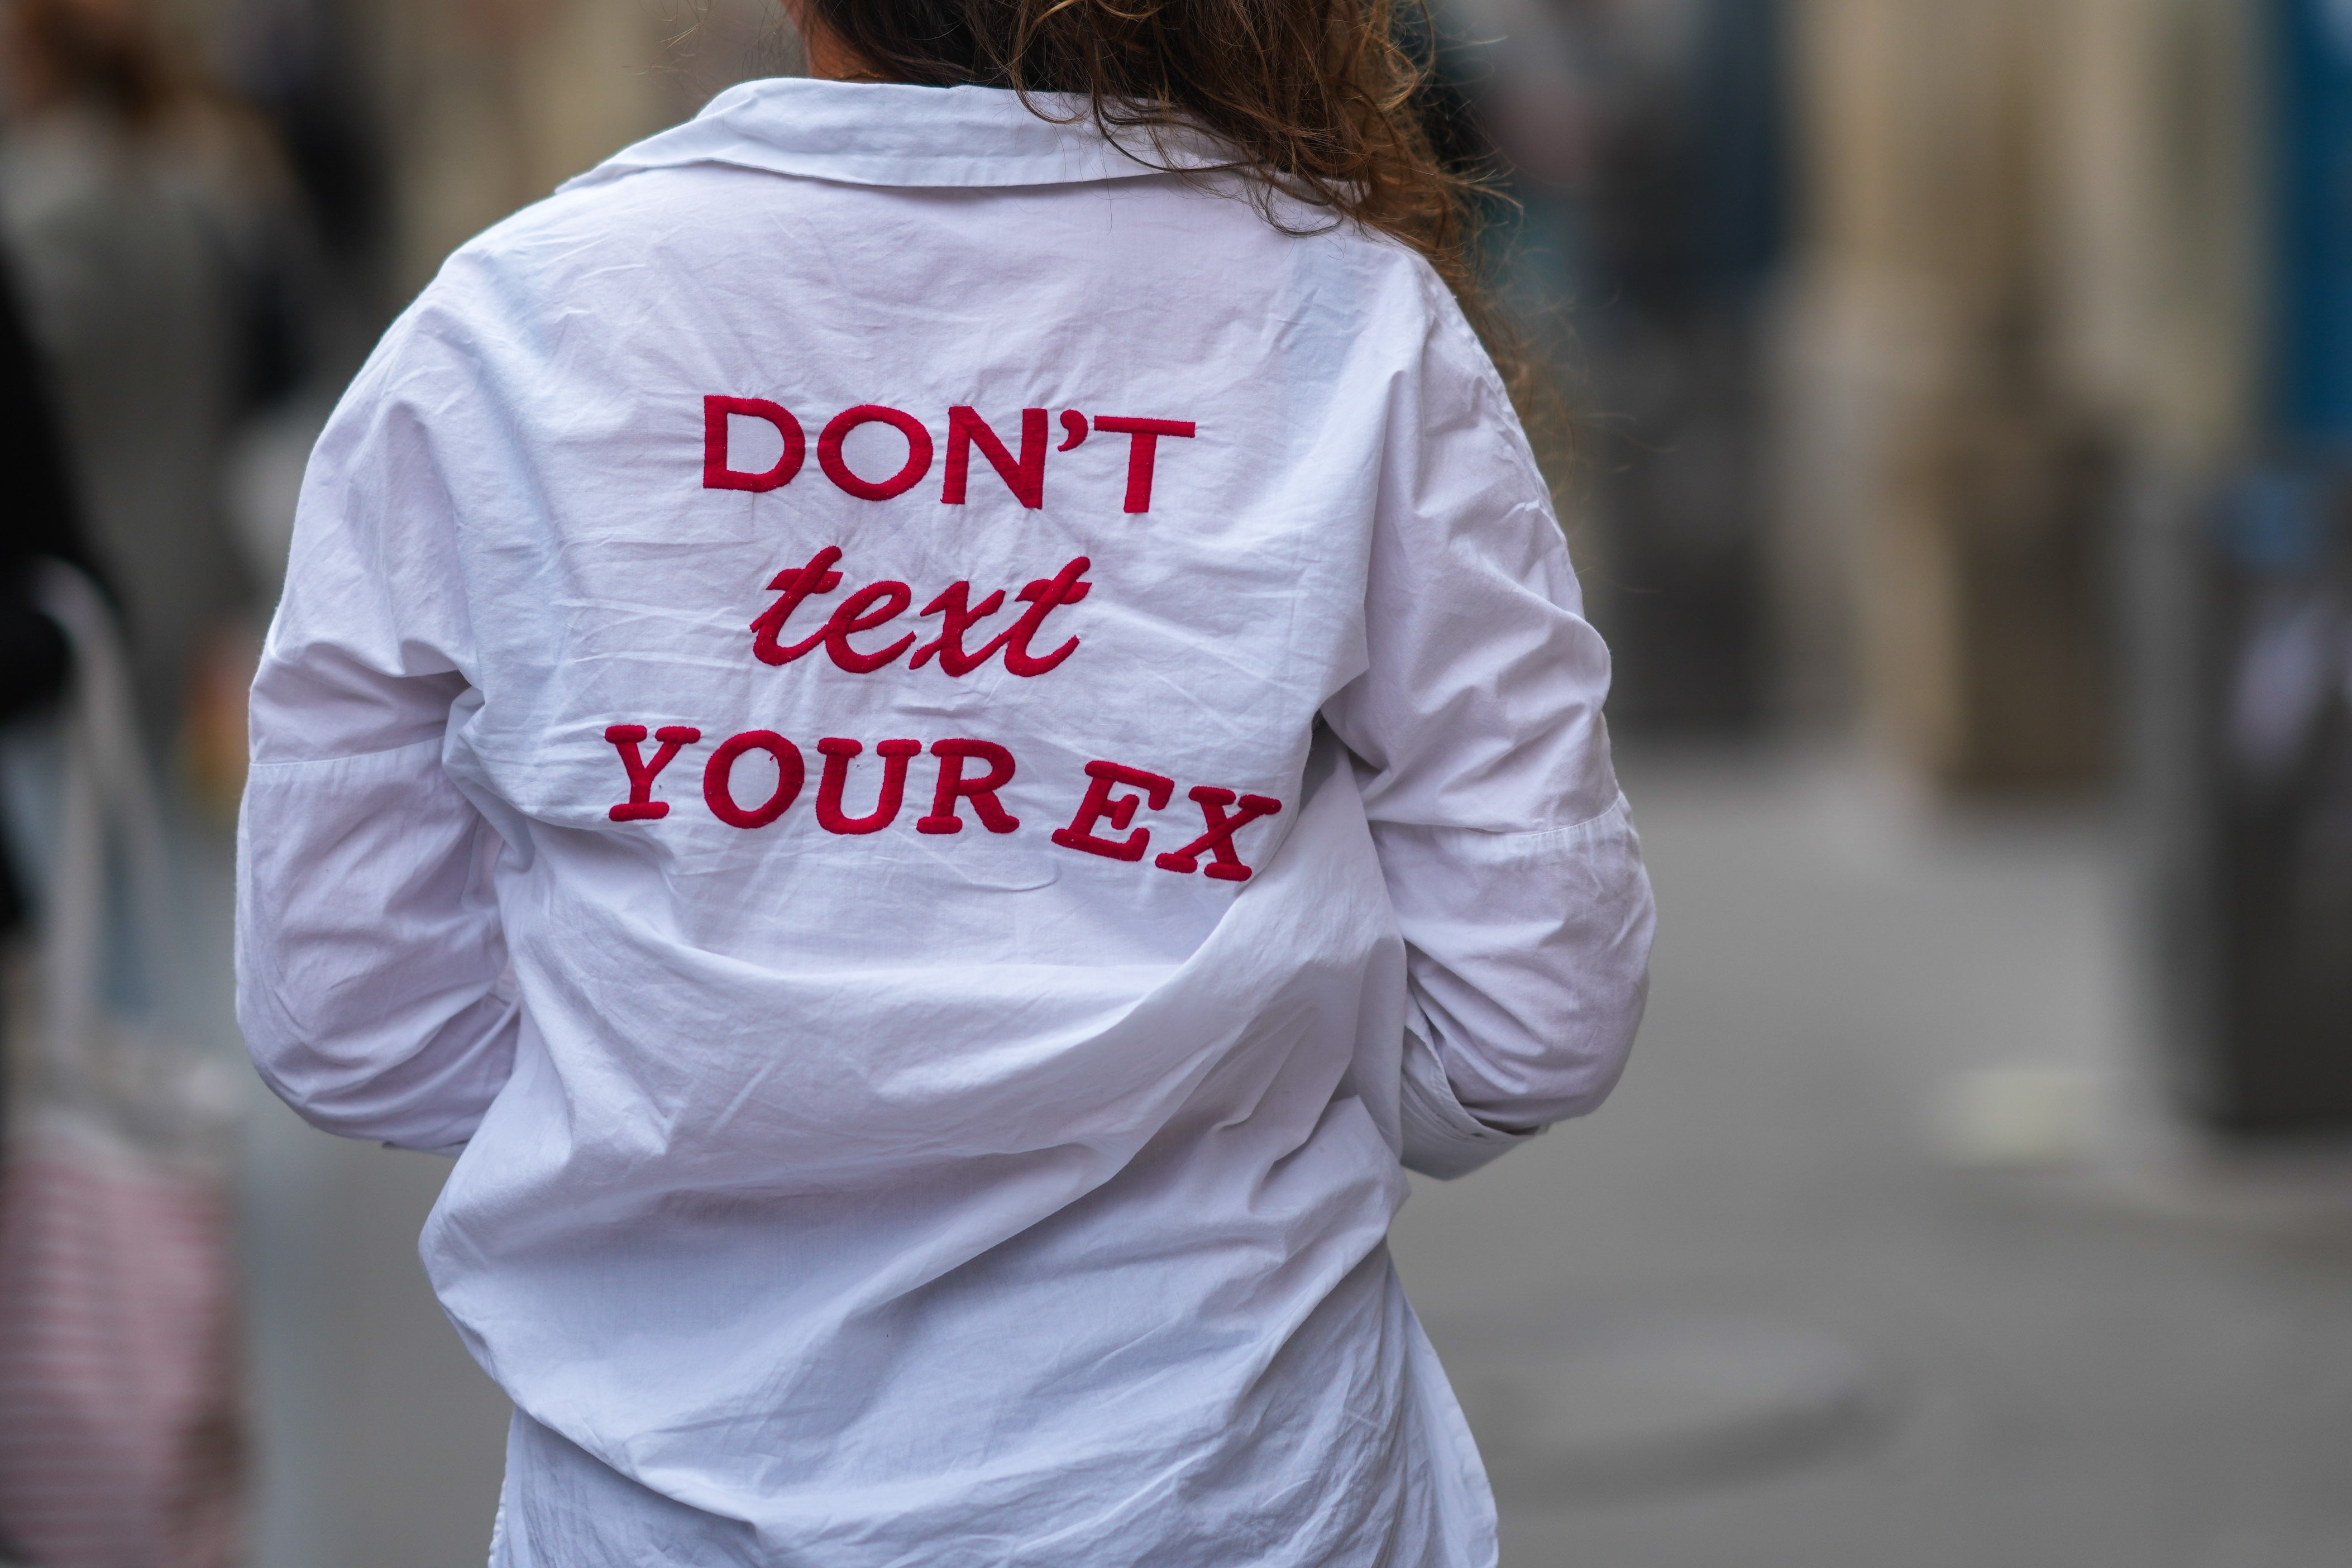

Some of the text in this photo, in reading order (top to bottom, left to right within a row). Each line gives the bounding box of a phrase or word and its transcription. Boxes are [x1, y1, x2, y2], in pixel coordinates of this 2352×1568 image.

[703, 395, 1196, 514] DON'T
[750, 546, 1091, 677] text
[605, 724, 1282, 882] YOUR EX
